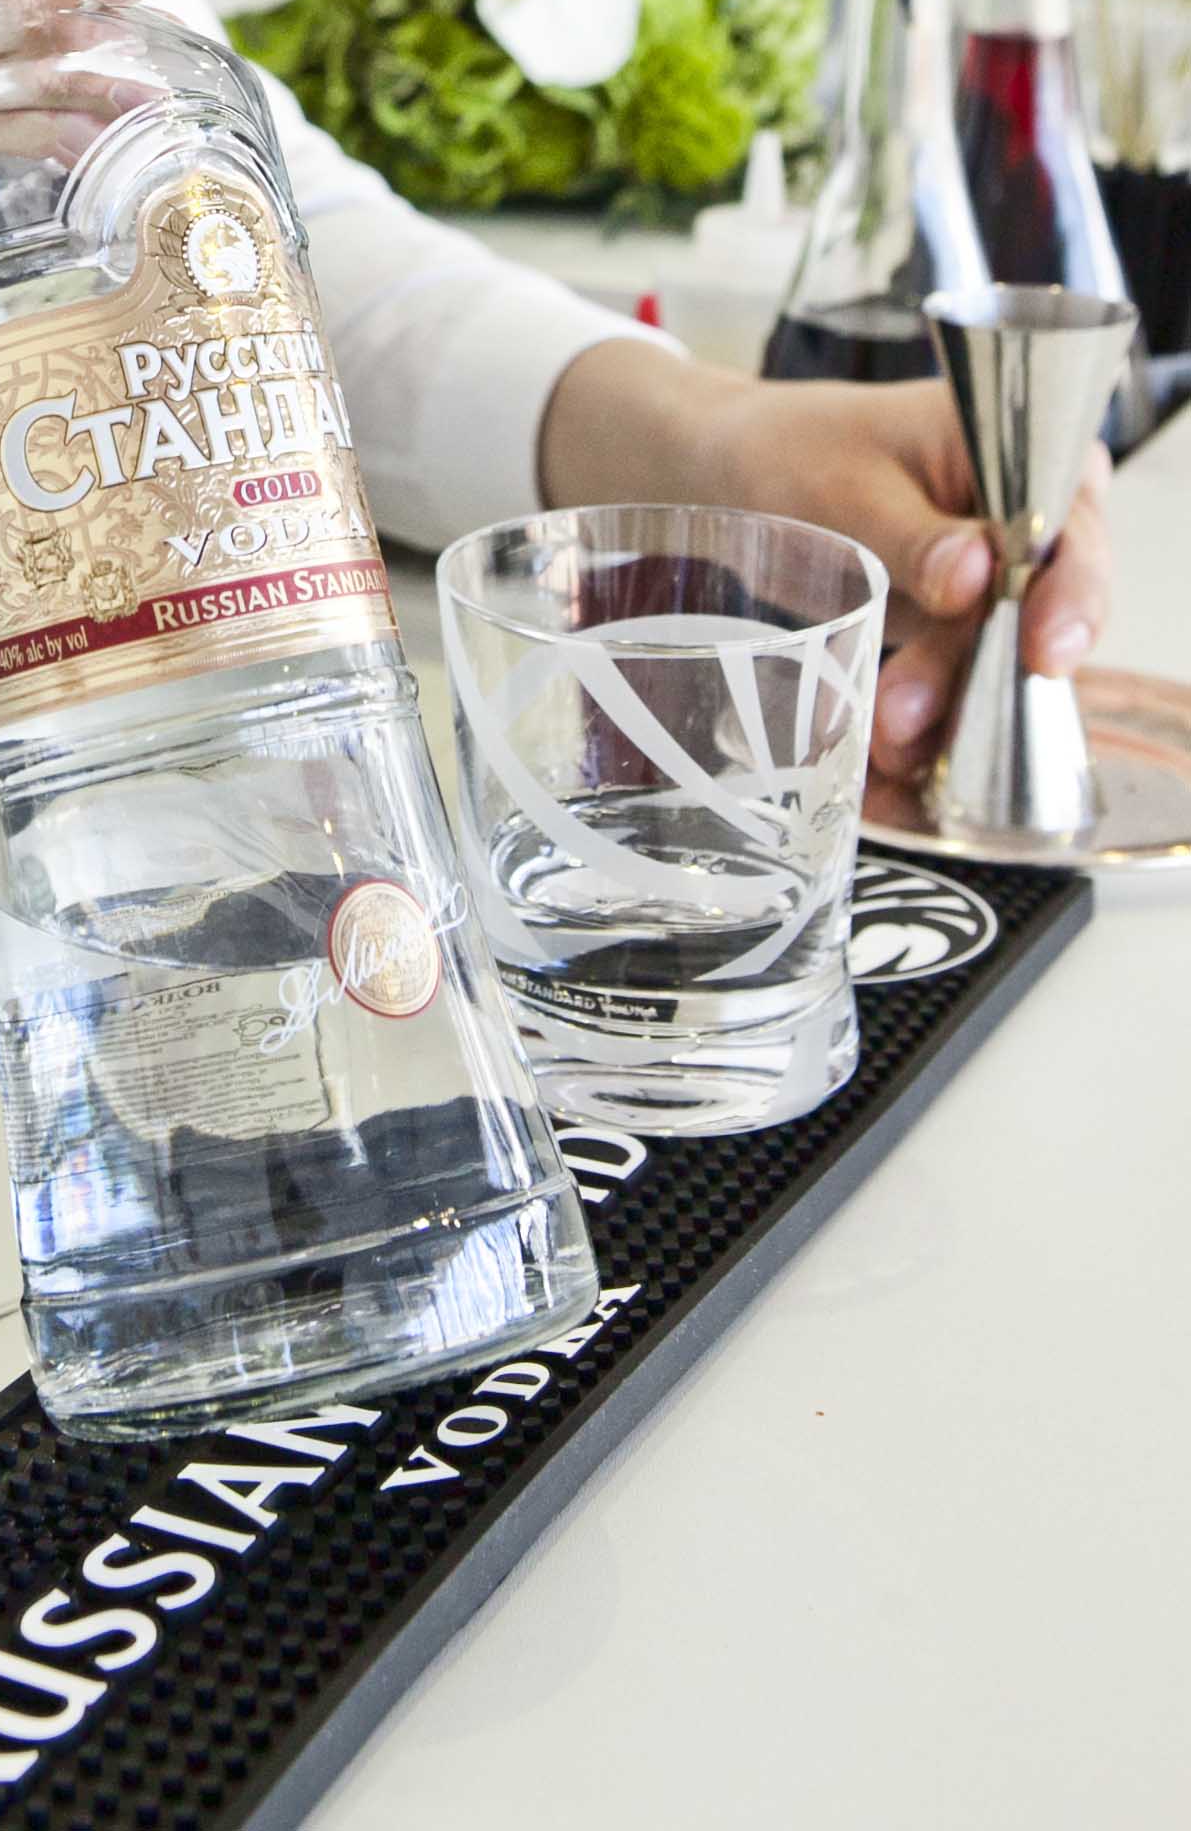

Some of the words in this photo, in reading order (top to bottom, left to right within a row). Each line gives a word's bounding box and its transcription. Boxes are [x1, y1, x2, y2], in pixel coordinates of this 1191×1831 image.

[240, 471, 318, 505] GOLD
[163, 507, 369, 568] VODKA
[152, 579, 289, 632] RUSSIAN
[0, 644, 24, 670] 40%
[26, 639, 45, 663] alc
[45, 634, 62, 661] by
[66, 624, 88, 650] vol
